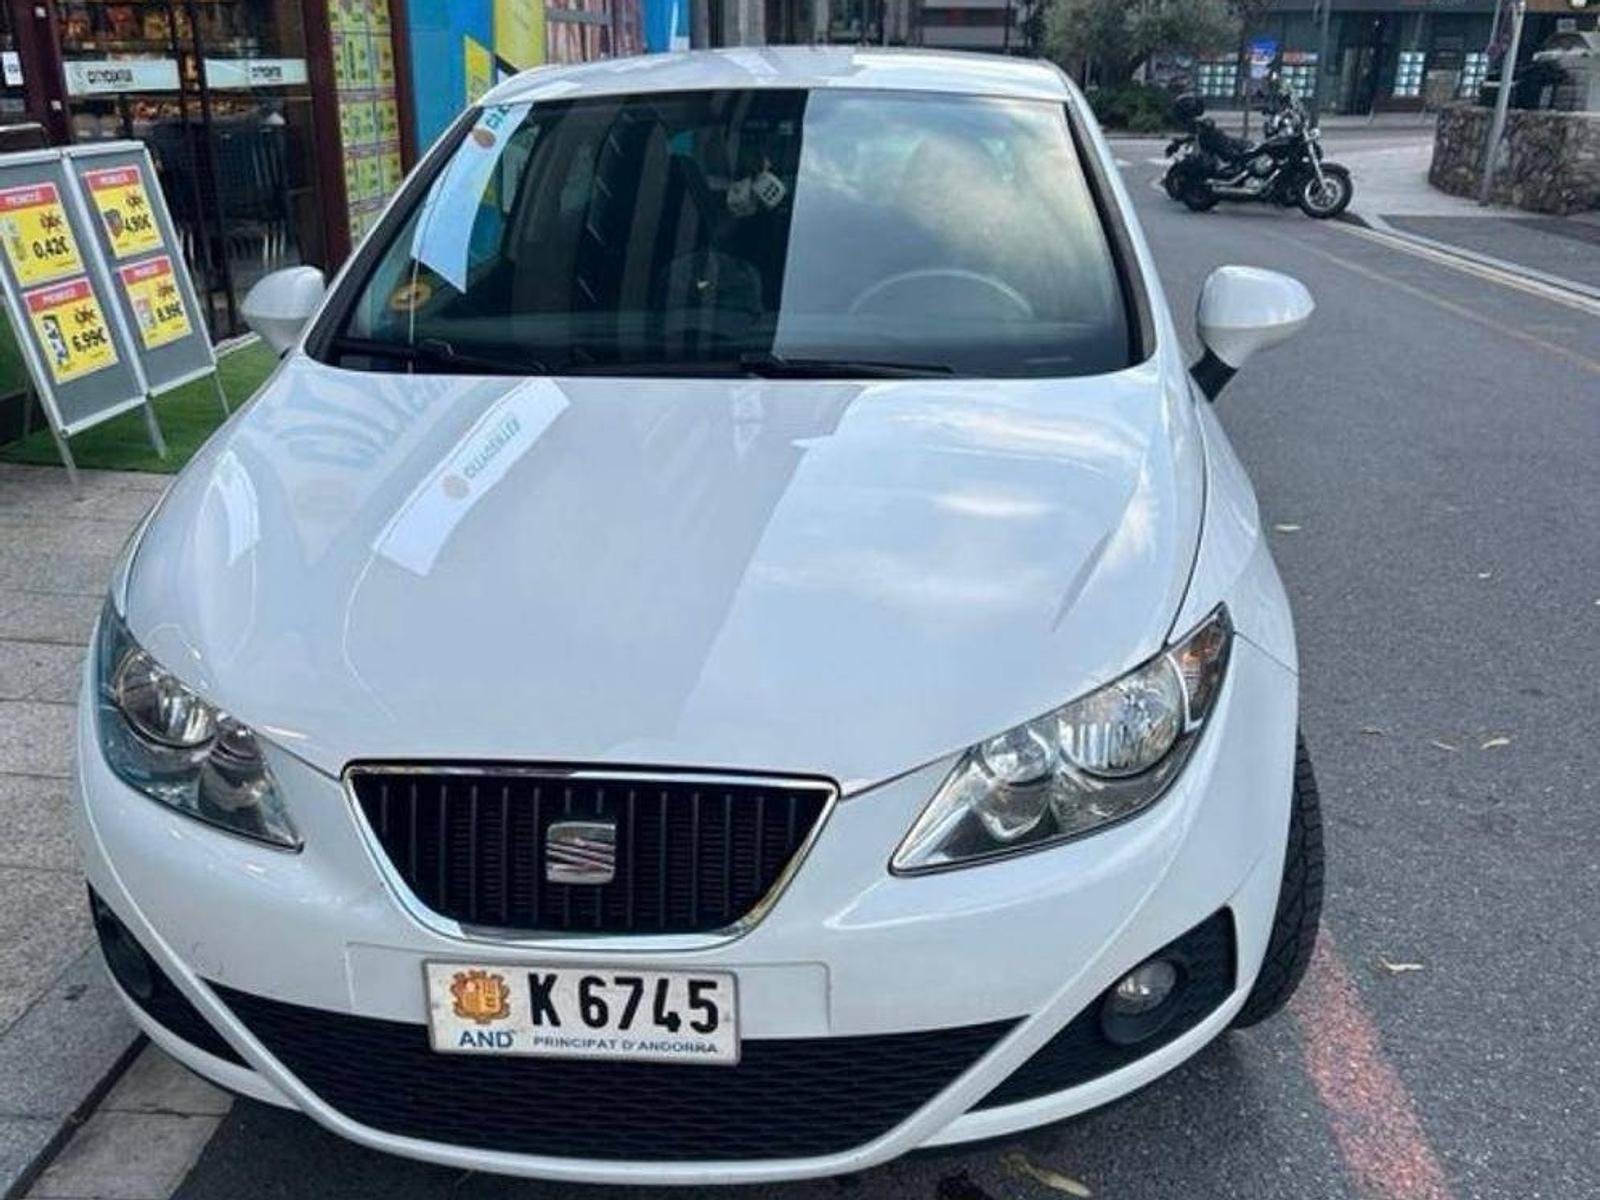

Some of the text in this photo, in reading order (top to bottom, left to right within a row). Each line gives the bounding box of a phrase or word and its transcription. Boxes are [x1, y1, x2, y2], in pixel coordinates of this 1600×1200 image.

[528, 972, 719, 1034] K 6745
[459, 1030, 514, 1049] AND
[533, 1035, 718, 1054] PRINCIPAT D'ANDORRA
